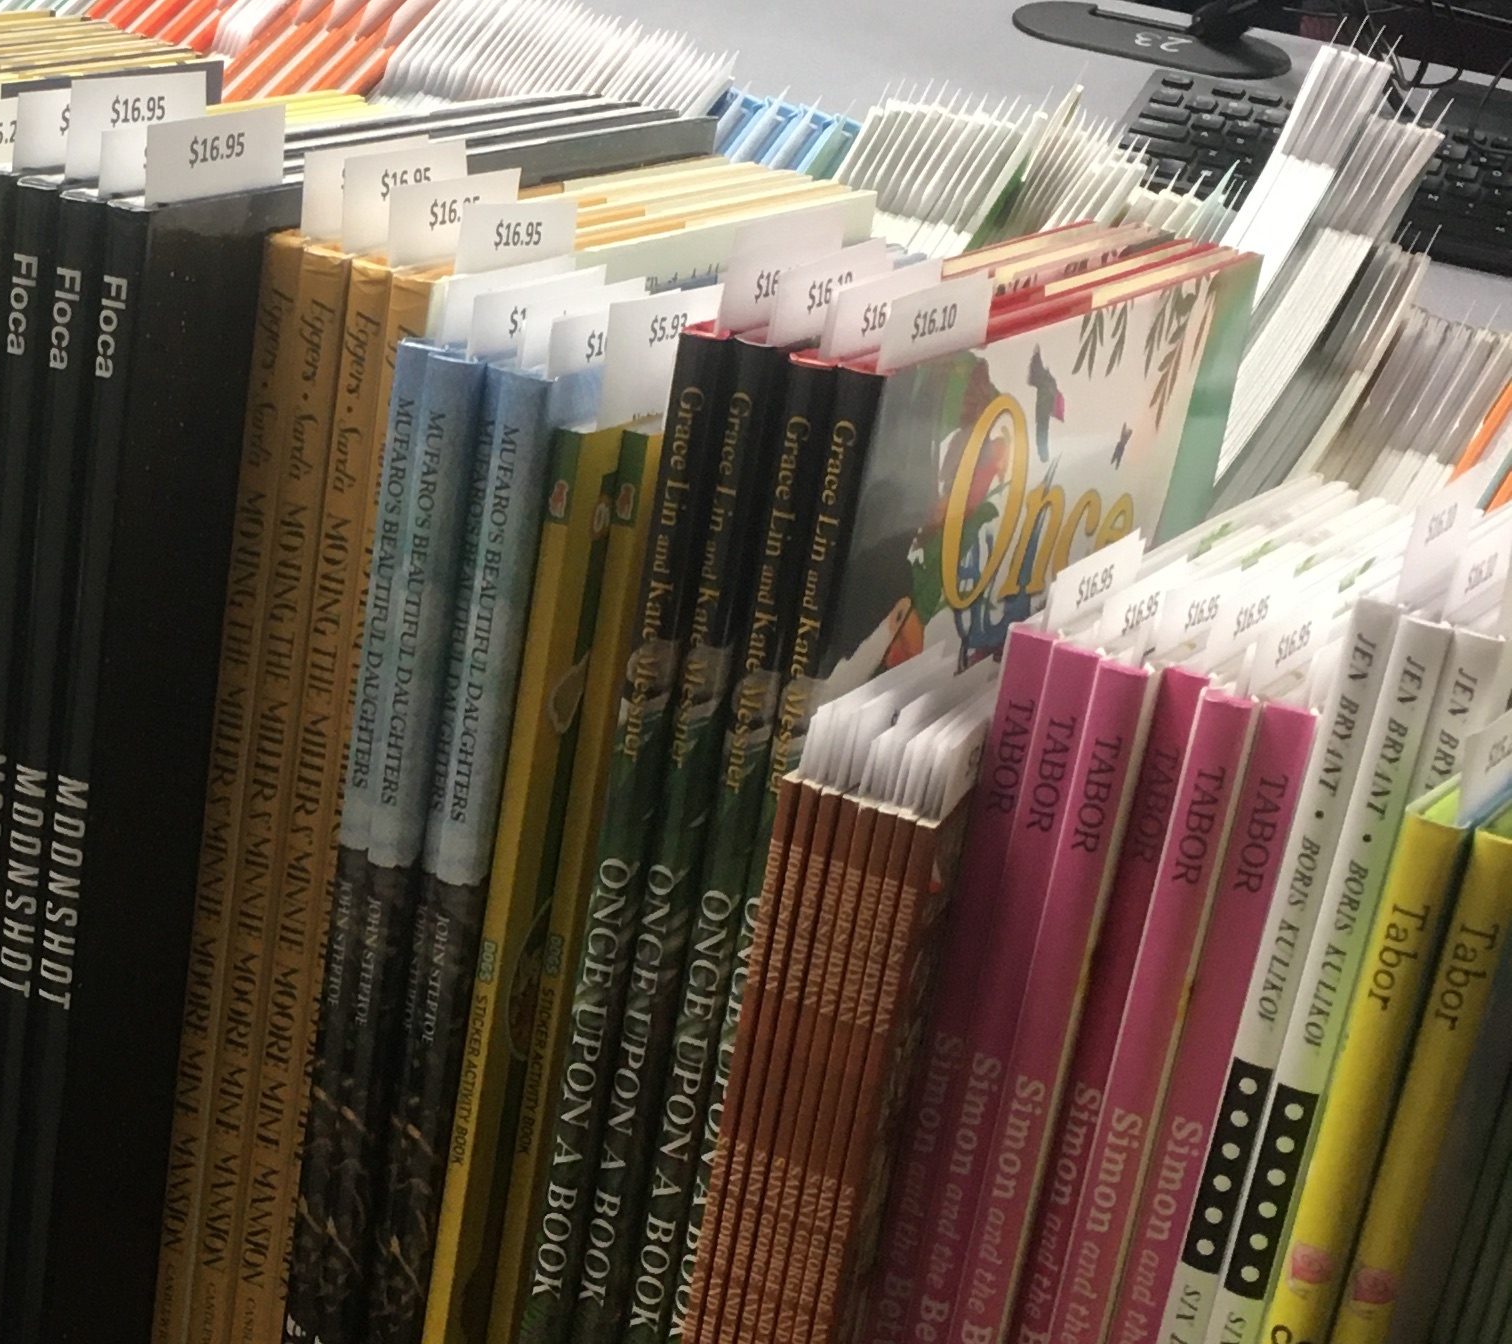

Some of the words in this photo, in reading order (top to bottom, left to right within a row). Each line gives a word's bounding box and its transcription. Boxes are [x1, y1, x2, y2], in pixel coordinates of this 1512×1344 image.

[110, 95, 166, 125] $16.95
[189, 132, 246, 165] $16.95
[493, 221, 543, 249] $16.95
[94, 274, 128, 379] Floca
[347, 310, 382, 403] Eggers
[649, 313, 688, 345] $5.93
[910, 302, 959, 340] $16.10
[484, 424, 520, 543] MUFARO'S
[820, 419, 857, 509] Grace
[940, 394, 1134, 610] Once
[811, 514, 839, 565] Lin
[469, 545, 503, 678] BEAUTIFUL
[1076, 564, 1117, 607] $16.95
[1233, 594, 1271, 640] $16.95
[790, 606, 820, 678] Kate
[1346, 632, 1378, 684] JEN
[451, 680, 486, 825] DAUGHTERS
[1318, 694, 1361, 800] BRYANT
[1069, 733, 1124, 856] TABOR
[1232, 774, 1289, 895] TABOR
[38, 772, 90, 1011] MOONSHOT
[1284, 833, 1326, 910] BORIS
[433, 914, 452, 961] JOHN
[575, 857, 632, 992] ONCE
[1369, 902, 1433, 1014] Tabor
[423, 965, 444, 1046] STEPTOE
[470, 994, 488, 1048] STICKER
[459, 1056, 477, 1120] ACTIVITY
[559, 1004, 608, 1130] UPON
[451, 1125, 466, 1167] BOOK
[1087, 1106, 1143, 1234] Simon
[531, 1186, 580, 1301] BOOK
[1175, 1281, 1202, 1333] SIX
